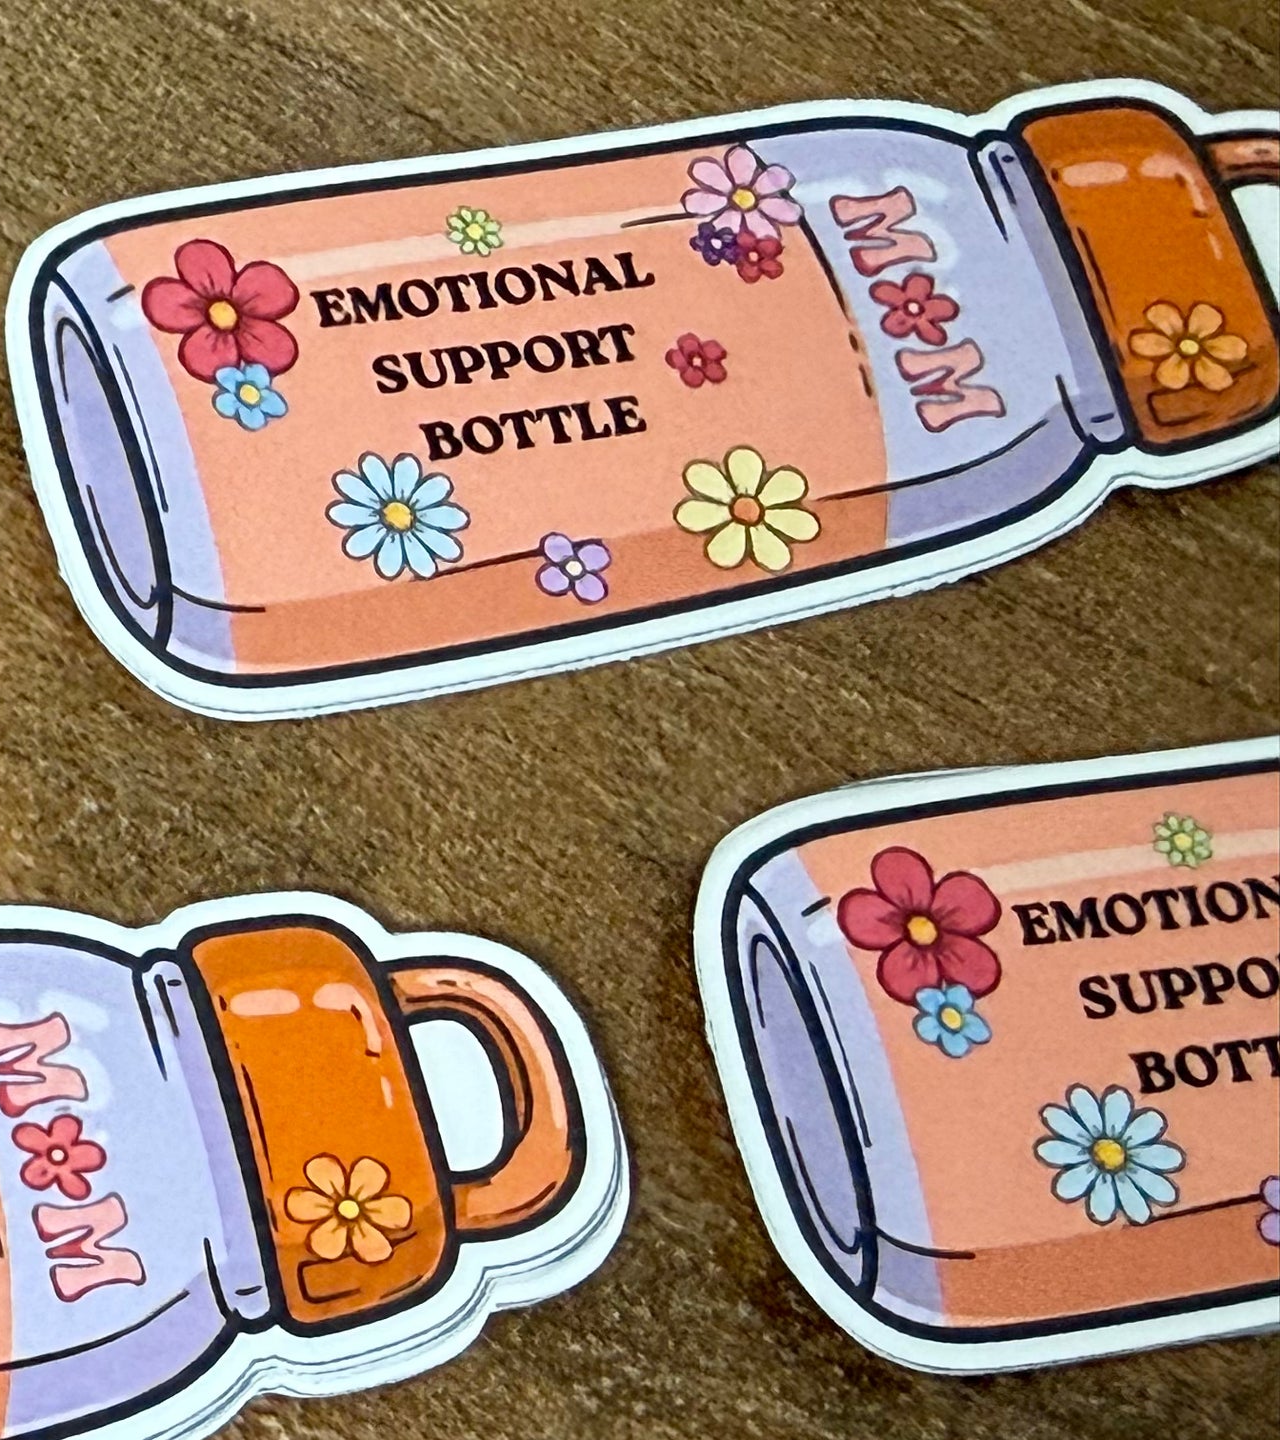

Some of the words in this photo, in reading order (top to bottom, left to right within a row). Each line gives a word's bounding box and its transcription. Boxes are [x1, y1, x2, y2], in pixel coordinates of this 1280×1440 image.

[308, 251, 657, 329] EMOTIONAL
[371, 322, 636, 395] SUPPORT
[418, 394, 648, 463] BOTTLE
